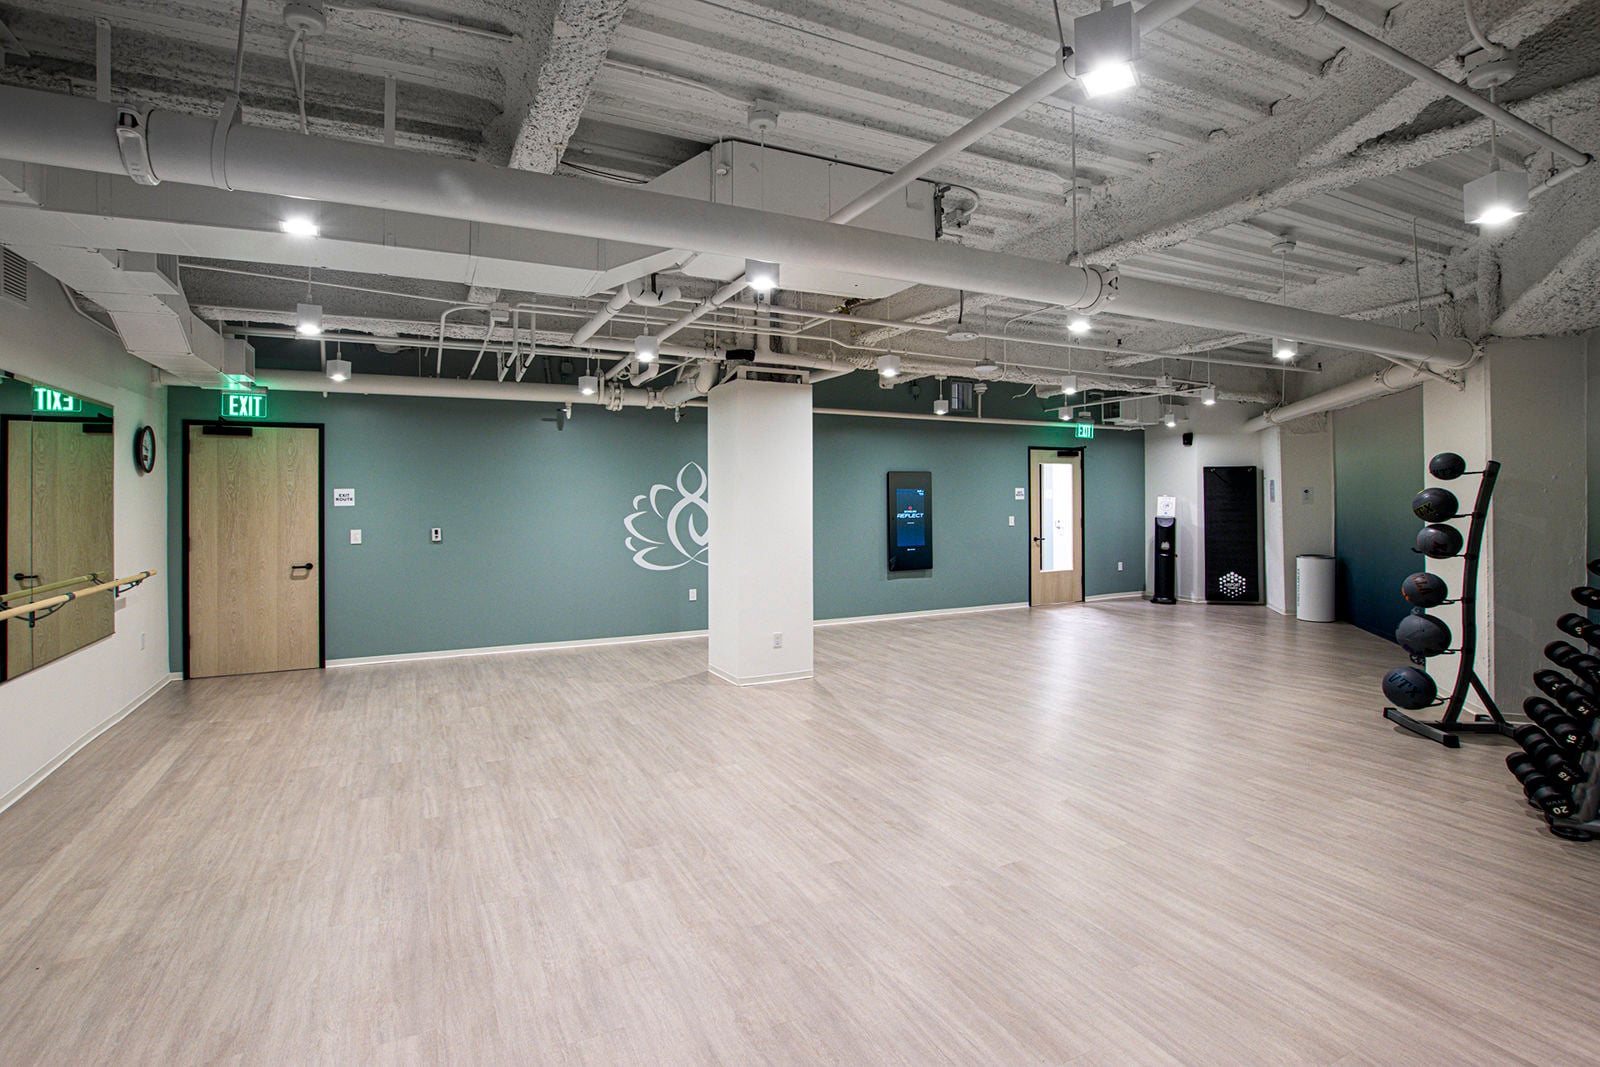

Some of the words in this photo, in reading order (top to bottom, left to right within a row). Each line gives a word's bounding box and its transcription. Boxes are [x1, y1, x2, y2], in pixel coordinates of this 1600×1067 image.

[229, 395, 263, 417] EXIT
[1078, 423, 1091, 438] EXIT
[1388, 672, 1422, 698] VTX
[1566, 734, 1577, 744] 16
[1558, 771, 1571, 781] 18
[1552, 805, 1569, 815] 20
